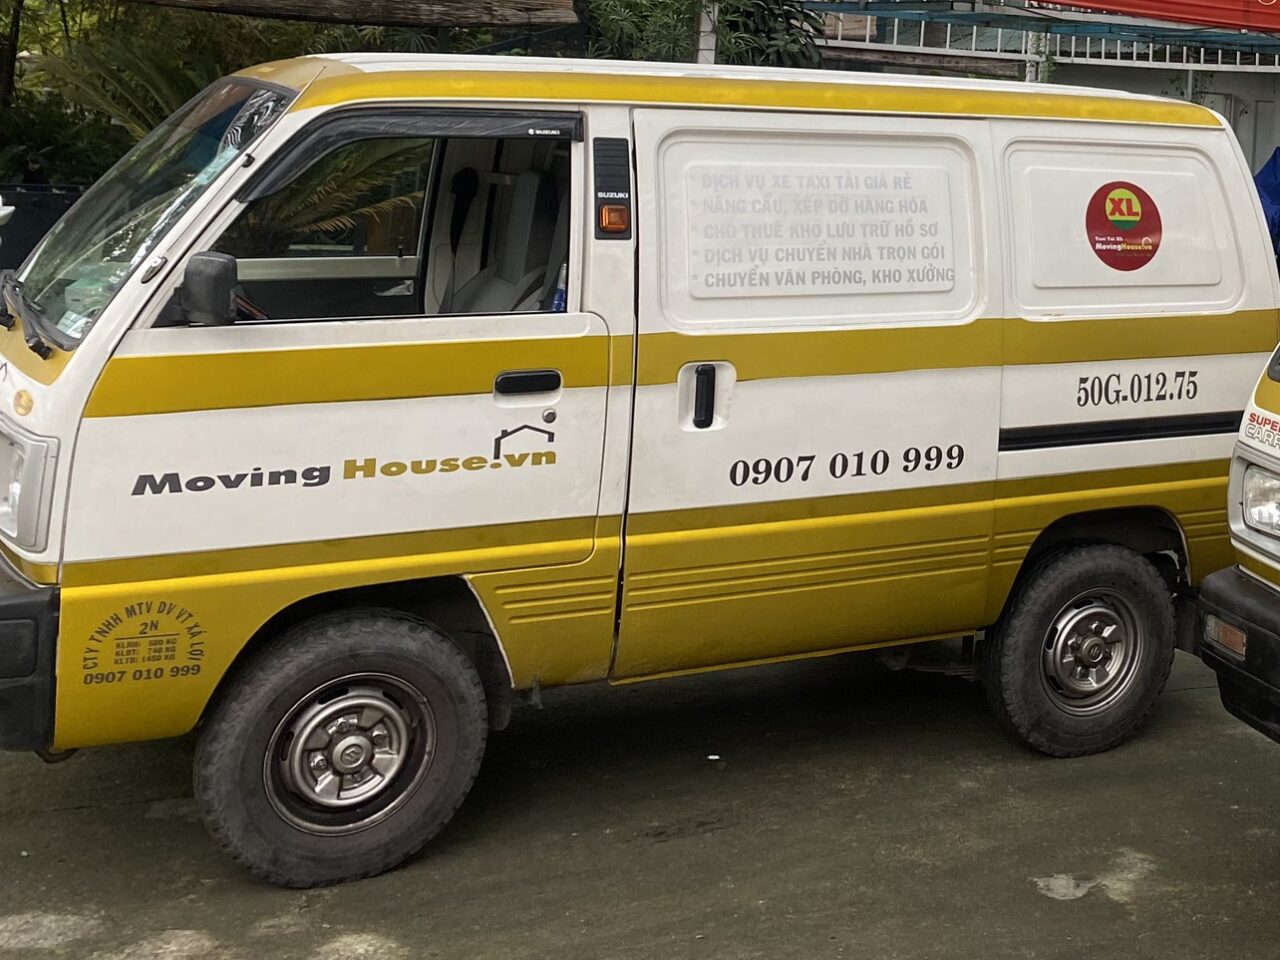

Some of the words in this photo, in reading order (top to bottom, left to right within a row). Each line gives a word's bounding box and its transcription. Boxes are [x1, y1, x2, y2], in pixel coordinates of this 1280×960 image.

[772, 175, 792, 189] XE
[799, 175, 830, 189] TAXI
[1109, 198, 1140, 216] XL
[789, 223, 822, 239] KHO
[704, 247, 742, 266] DỊCH
[748, 248, 769, 265] VỤ
[876, 246, 916, 263] TRỌN
[704, 265, 769, 288] CHUYỂN
[872, 269, 902, 284] KHO
[1077, 370, 1199, 408] 50G.012.75
[730, 456, 814, 487] 0907
[829, 449, 889, 480] 010
[902, 444, 965, 474] 999
[125, 600, 153, 619] MTV
[157, 601, 176, 615] DV
[175, 608, 193, 624] VT
[89, 613, 123, 643] TNHH
[139, 620, 159, 635] 2N
[83, 647, 100, 670] CTY
[83, 671, 126, 685] 0907
[132, 668, 164, 680] 010
[170, 664, 201, 677] 999
